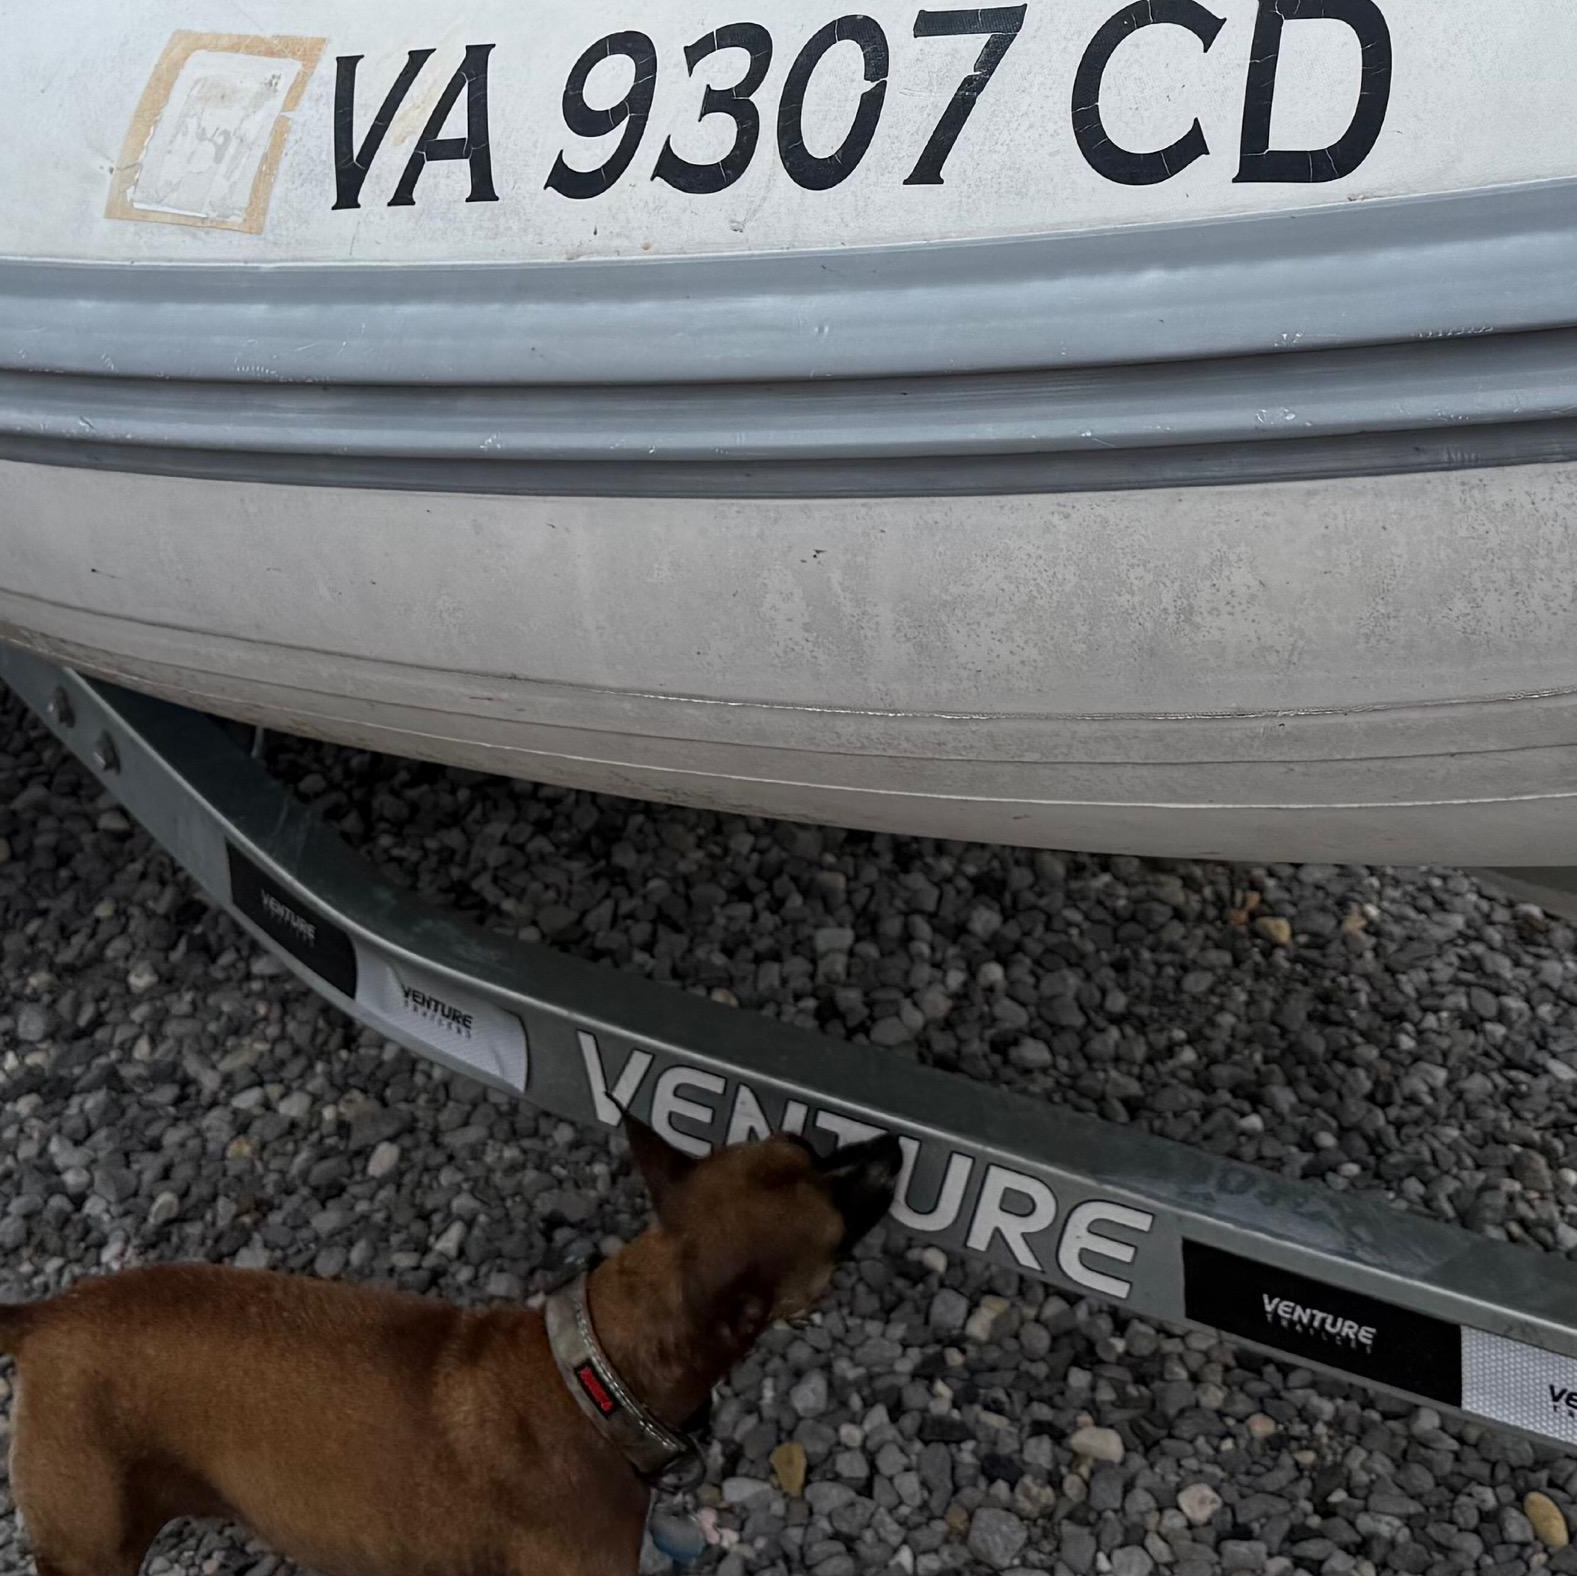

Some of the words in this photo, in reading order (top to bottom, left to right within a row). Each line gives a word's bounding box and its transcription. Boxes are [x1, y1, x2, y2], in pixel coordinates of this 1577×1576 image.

[332, 43, 500, 211] VA
[543, 2, 1028, 200] 9307
[403, 982, 474, 1030] VENTURE
[1262, 1293, 1377, 1346] VENTURE
